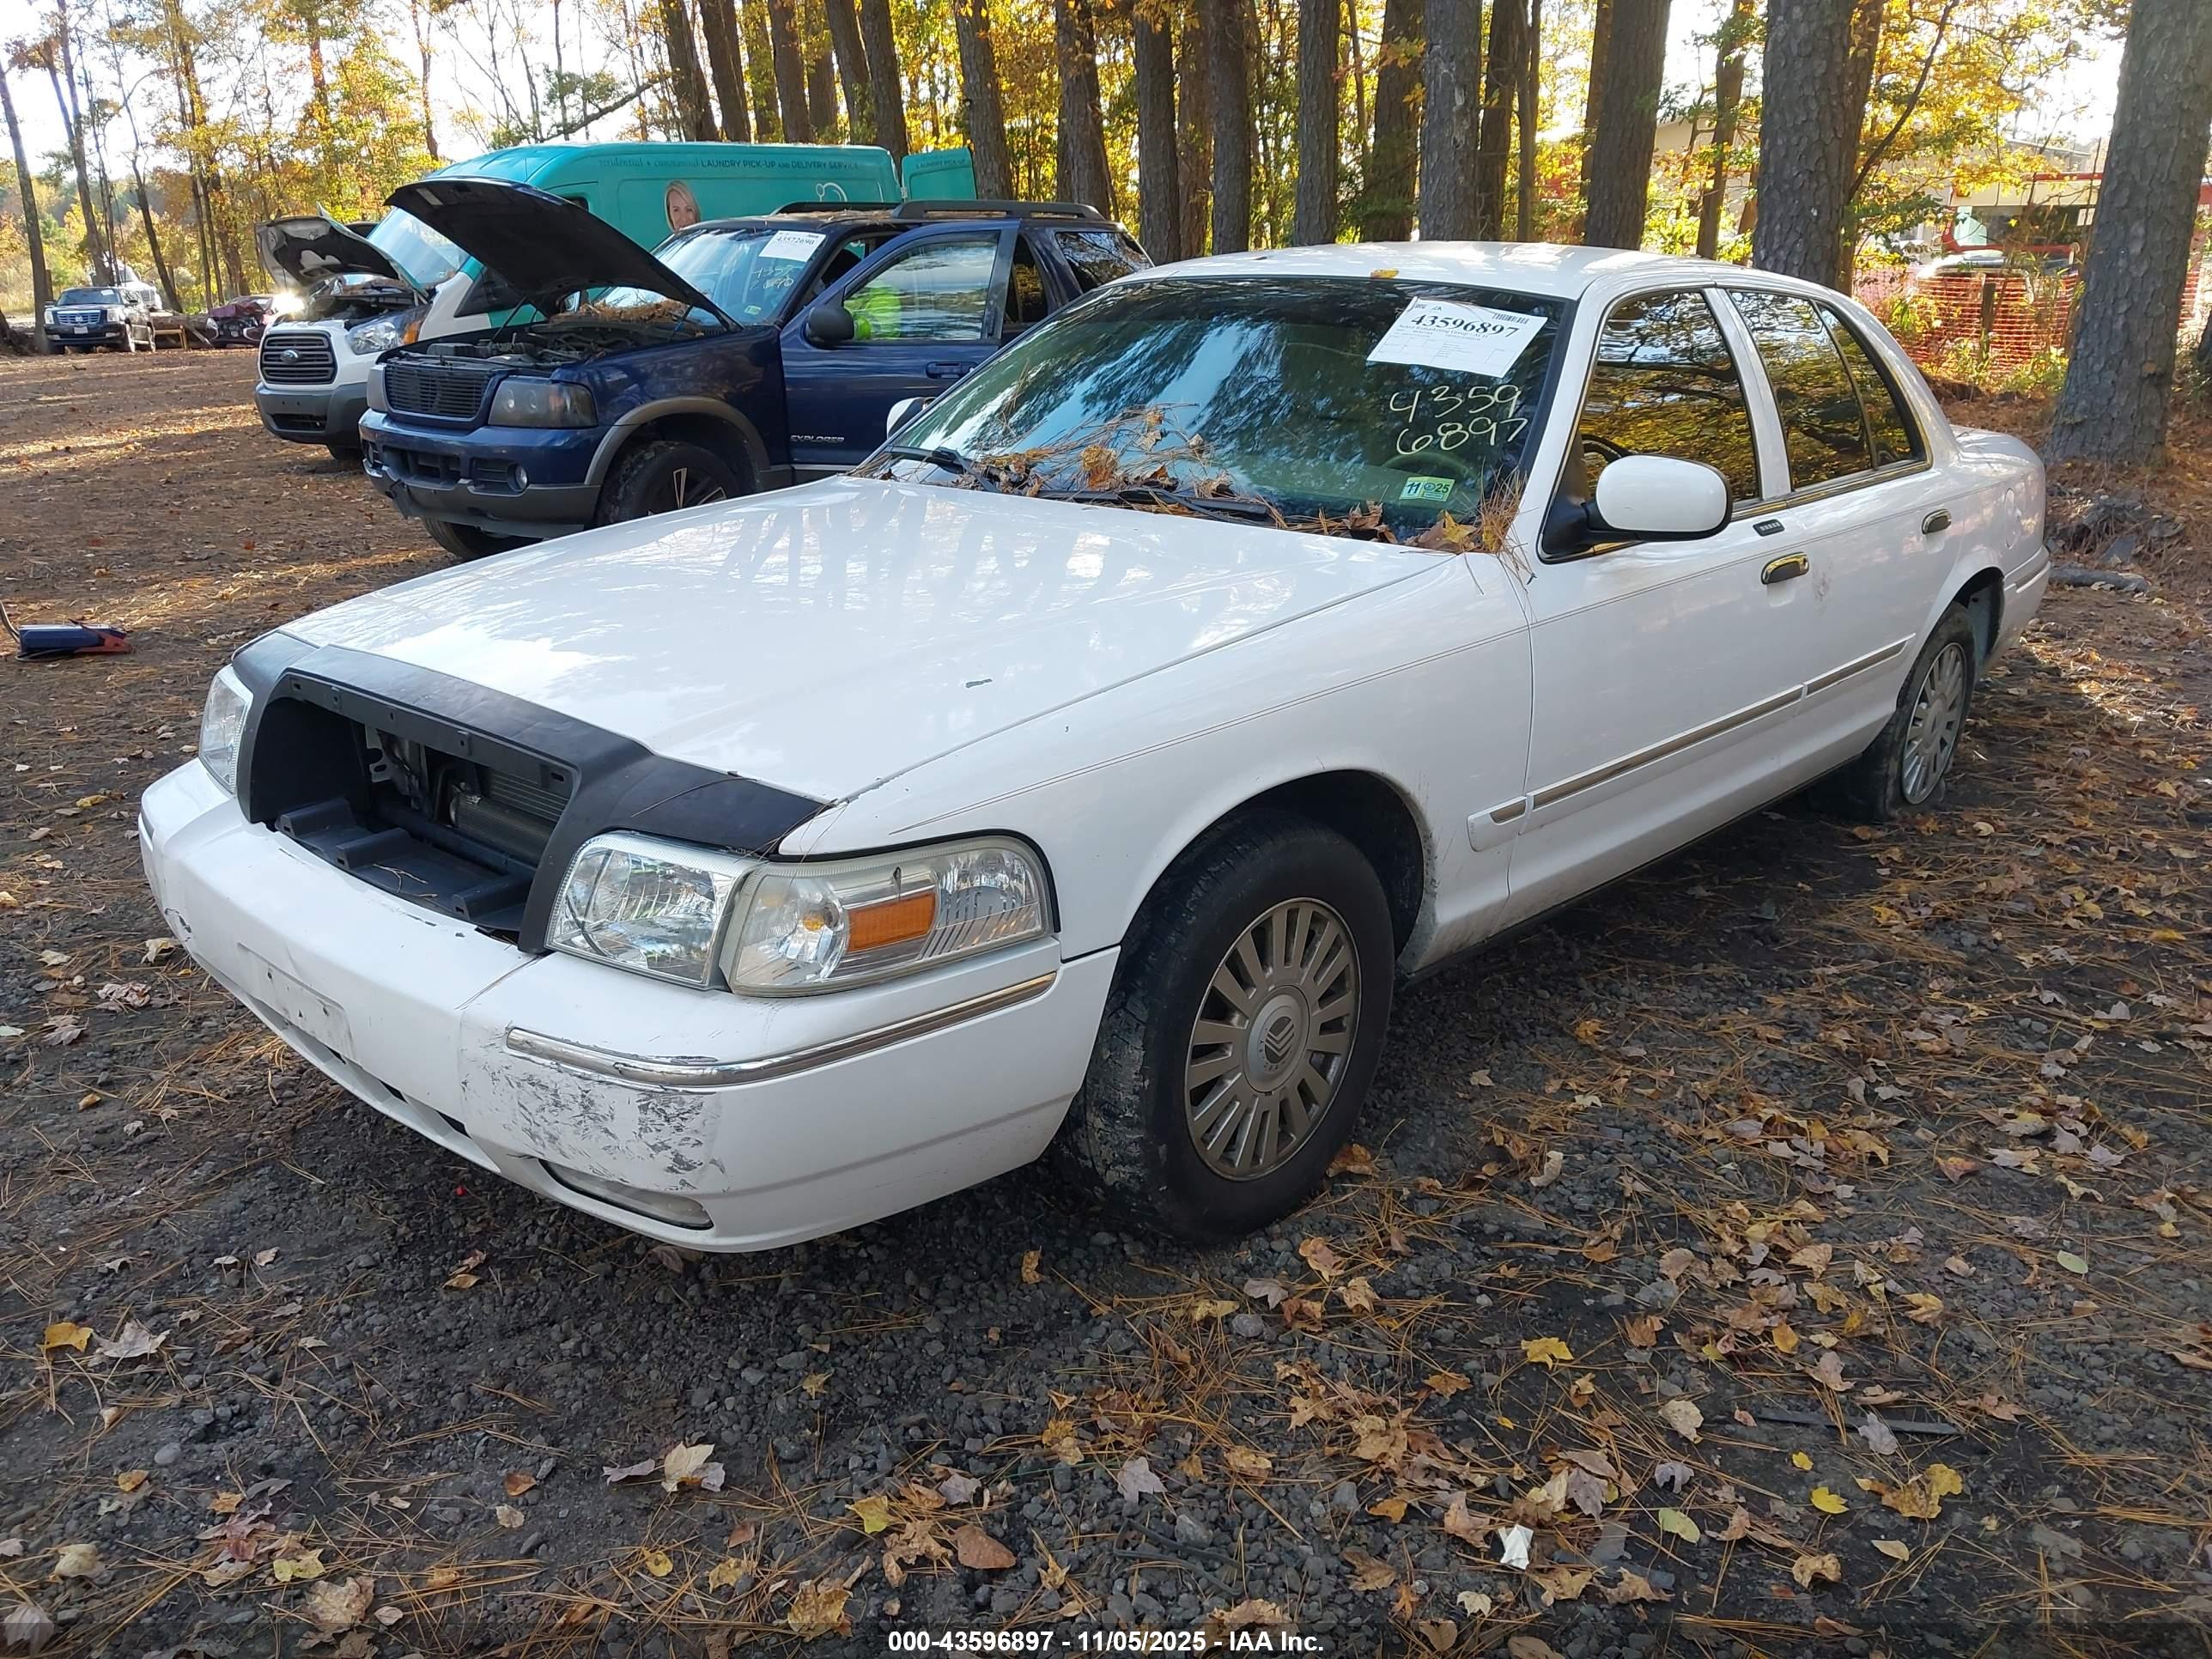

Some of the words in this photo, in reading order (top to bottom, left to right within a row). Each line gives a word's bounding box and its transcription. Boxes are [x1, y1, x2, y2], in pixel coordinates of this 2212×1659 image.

[701, 158, 740, 168] LAUNDRY
[743, 159, 776, 169] PICK-UP
[791, 161, 826, 169] DELIVERY
[1411, 313, 1521, 338] 43596897
[1389, 384, 1522, 423] 4359
[1396, 416, 1528, 455] 6897
[1407, 482, 1422, 495] 11
[1434, 483, 1450, 494] 25
